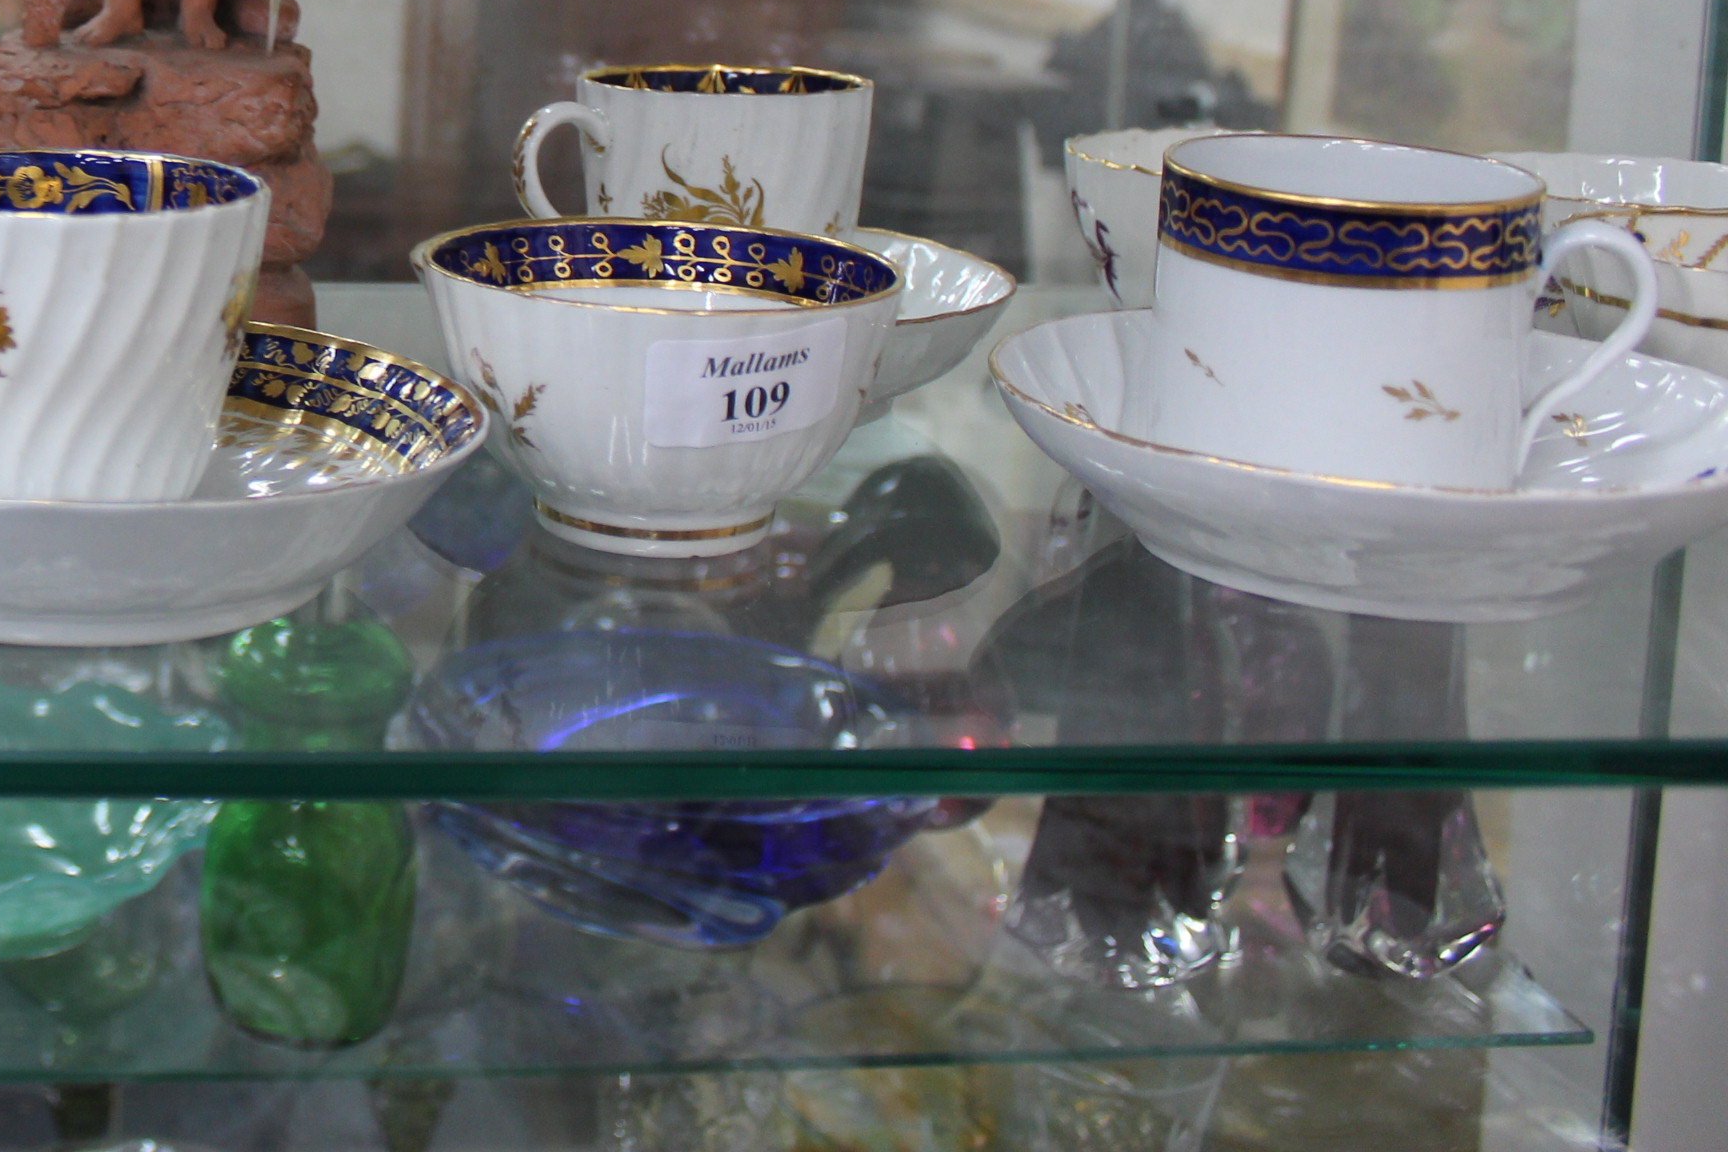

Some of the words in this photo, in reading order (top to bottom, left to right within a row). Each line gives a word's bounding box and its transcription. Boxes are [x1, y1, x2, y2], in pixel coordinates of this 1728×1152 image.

[701, 348, 810, 378] Mallams
[721, 381, 791, 422] 109
[731, 418, 776, 434] 12/01/15
